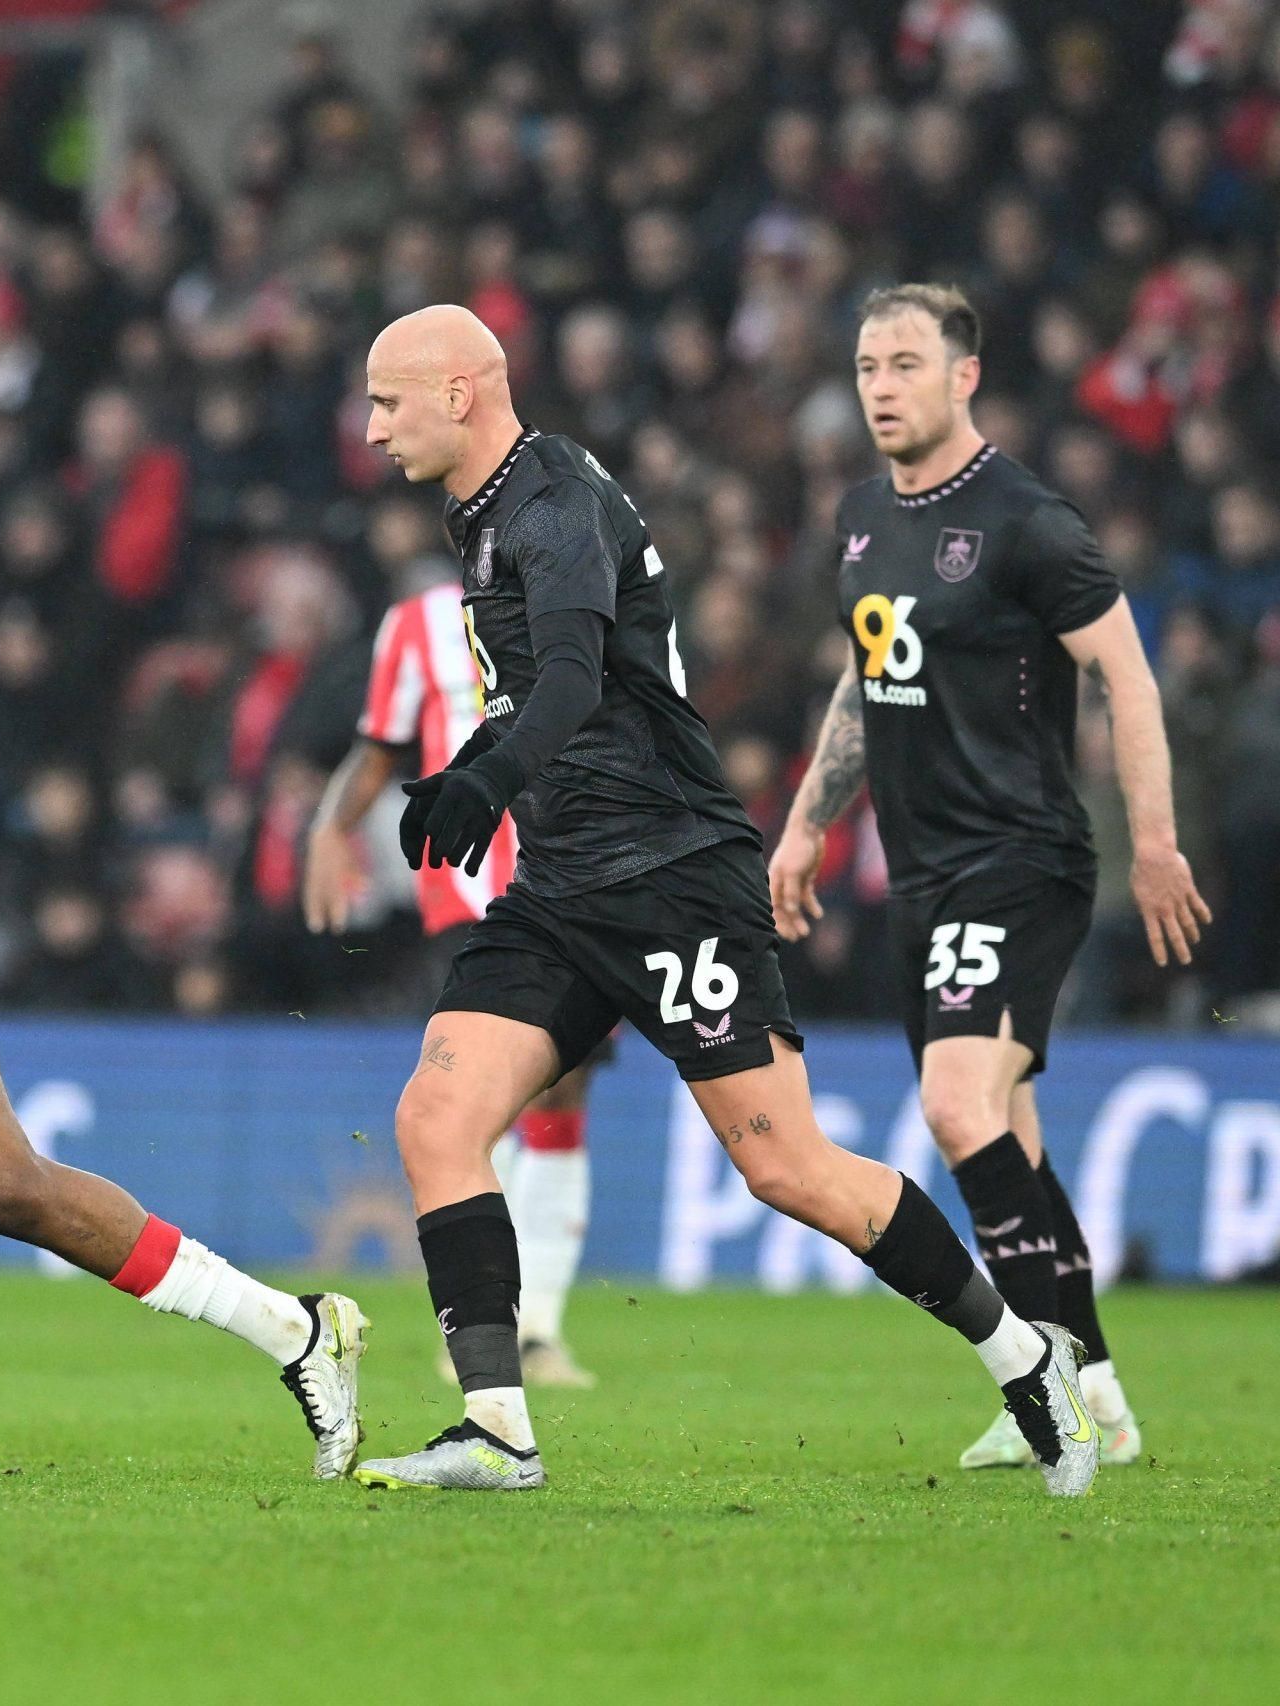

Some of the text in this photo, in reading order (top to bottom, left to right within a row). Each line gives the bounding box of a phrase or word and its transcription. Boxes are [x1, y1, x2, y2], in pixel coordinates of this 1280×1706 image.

[852, 593, 923, 680] 96
[644, 937, 739, 1024] 26
[924, 922, 1006, 990] 35
[700, 1033, 736, 1049] CASTORE
